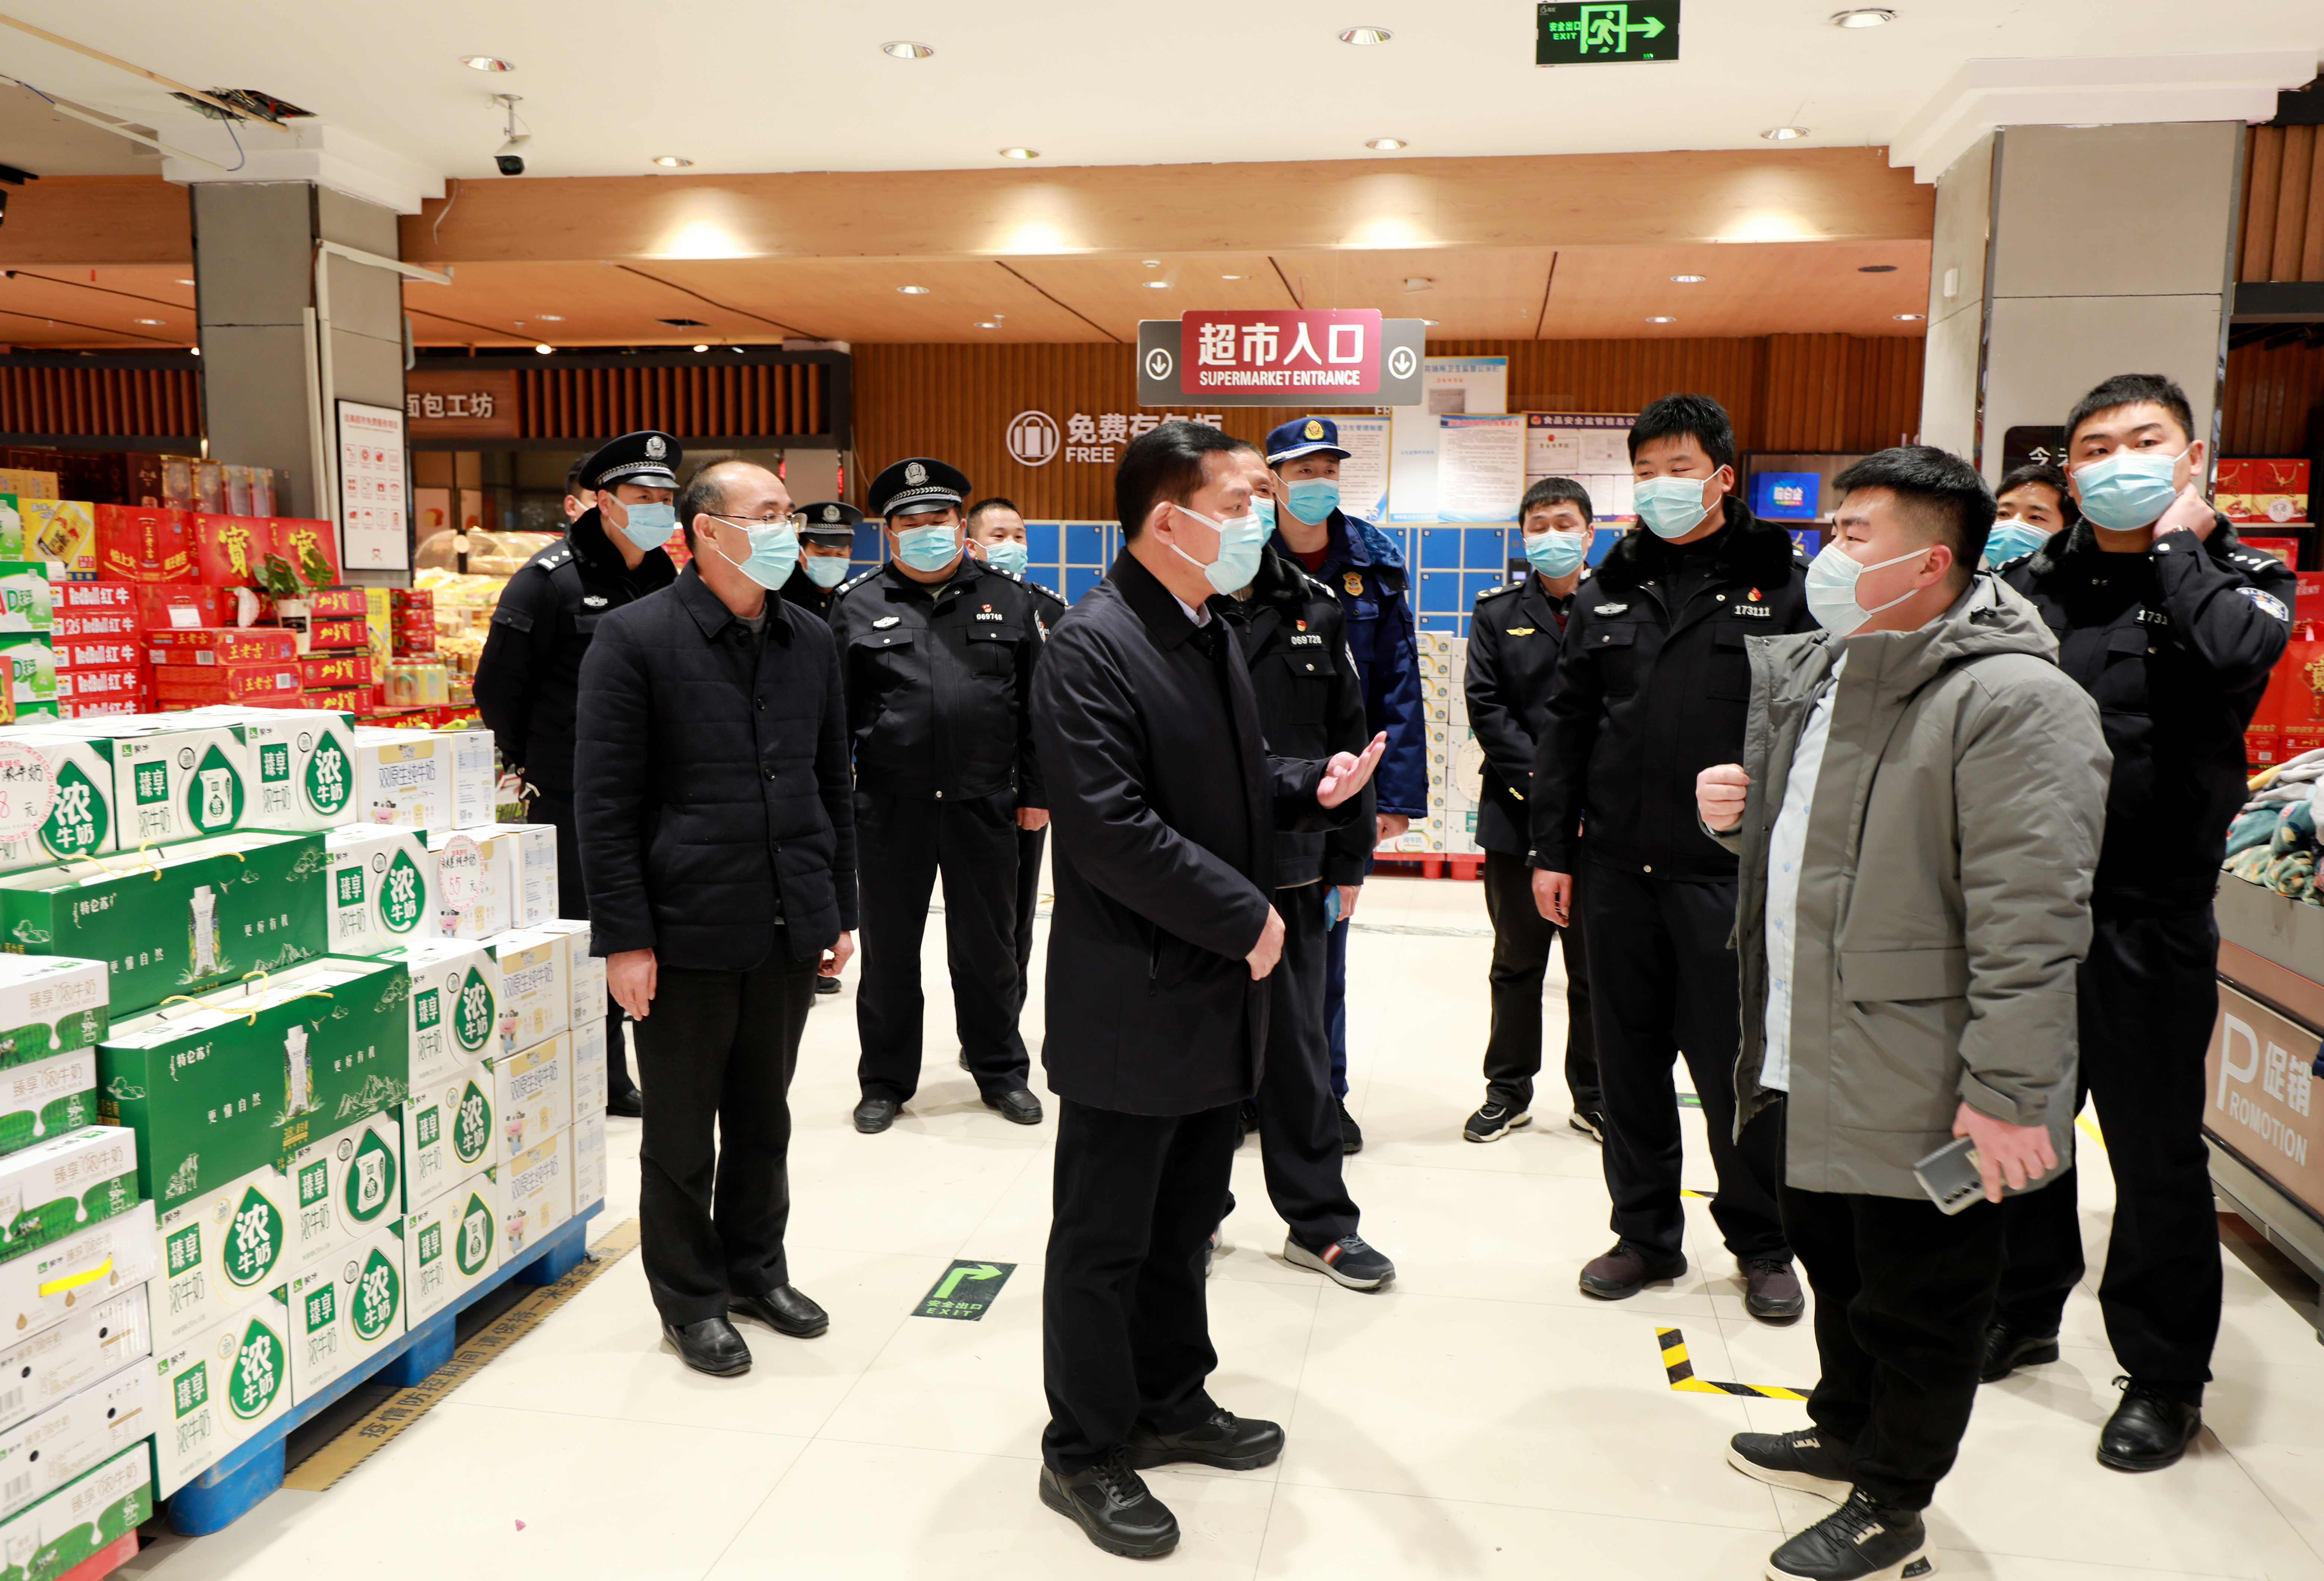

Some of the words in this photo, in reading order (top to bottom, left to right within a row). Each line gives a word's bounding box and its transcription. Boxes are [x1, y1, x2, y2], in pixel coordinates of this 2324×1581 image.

[1198, 322, 1364, 366] 超市入口
[1199, 371, 1291, 386] SUPERMARKET
[1293, 370, 1360, 385] ENTRANCE
[1066, 448, 1115, 463] FREE
[1734, 606, 1770, 616] 173111
[228, 642, 263, 660] 王老吉
[245, 676, 272, 691] 王老吉
[315, 747, 343, 784] 浓
[54, 781, 93, 826] 浓
[317, 783, 343, 803] 牛奶
[24, 801, 38, 818] 元
[56, 823, 95, 848] 牛奶
[390, 865, 416, 903] 浓
[449, 876, 461, 895] 55
[469, 879, 477, 892] 元
[390, 900, 416, 921] 牛奶
[244, 914, 289, 937] 更好有机
[110, 947, 165, 974] 更懂自然
[463, 982, 487, 1021] 浓
[465, 1017, 488, 1040] 牛奶
[334, 1045, 375, 1073] 更好有机
[2262, 1041, 2313, 1118] 促销
[208, 1092, 261, 1124] 更懂自然
[461, 1095, 483, 1134] 浓
[463, 1127, 485, 1152] 牛奶
[235, 1203, 271, 1253] 浓
[238, 1241, 272, 1274] 牛奶
[362, 1265, 391, 1309] 浓
[363, 1298, 391, 1328] 牛奶
[926, 1308, 973, 1317] EXIT
[927, 1300, 983, 1310] 安全出口
[358, 1350, 486, 1438] 疫情防控期间
[473, 1247, 622, 1350] 请保持一米安全离
[239, 1335, 274, 1385] 浓
[242, 1371, 274, 1406] 牛奶
